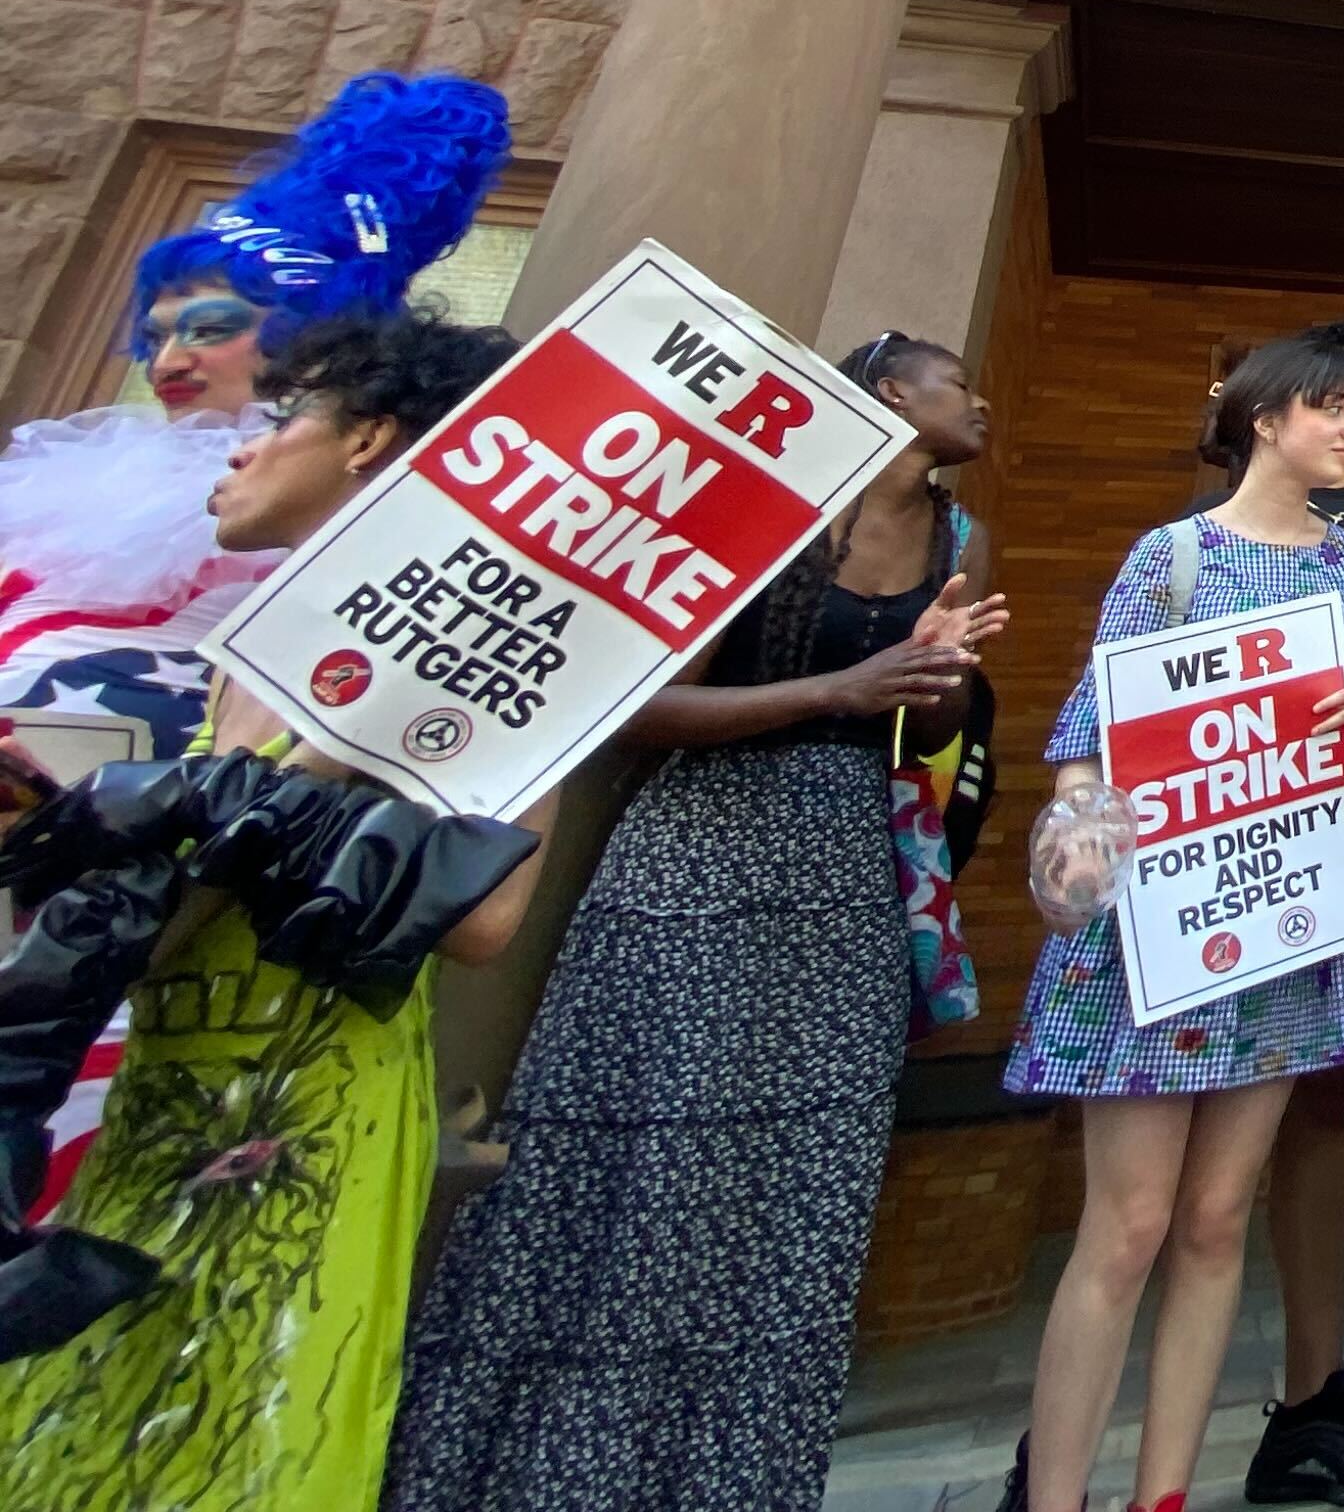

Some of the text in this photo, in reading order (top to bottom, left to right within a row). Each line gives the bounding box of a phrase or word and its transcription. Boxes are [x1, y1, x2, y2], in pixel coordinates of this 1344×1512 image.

[651, 320, 815, 460] WE R
[582, 409, 722, 519] ON
[442, 414, 736, 633] STRIKE
[385, 557, 568, 687] BETTER
[441, 536, 578, 640] FOR A
[334, 581, 547, 730] RUTGERS
[1162, 627, 1293, 691] WE R
[1189, 696, 1276, 761] ON
[1127, 731, 1344, 835] STRIKE
[1138, 797, 1342, 885] FOR DIGNITY
[1215, 848, 1283, 894] AND
[1178, 863, 1323, 936] RESPECT
